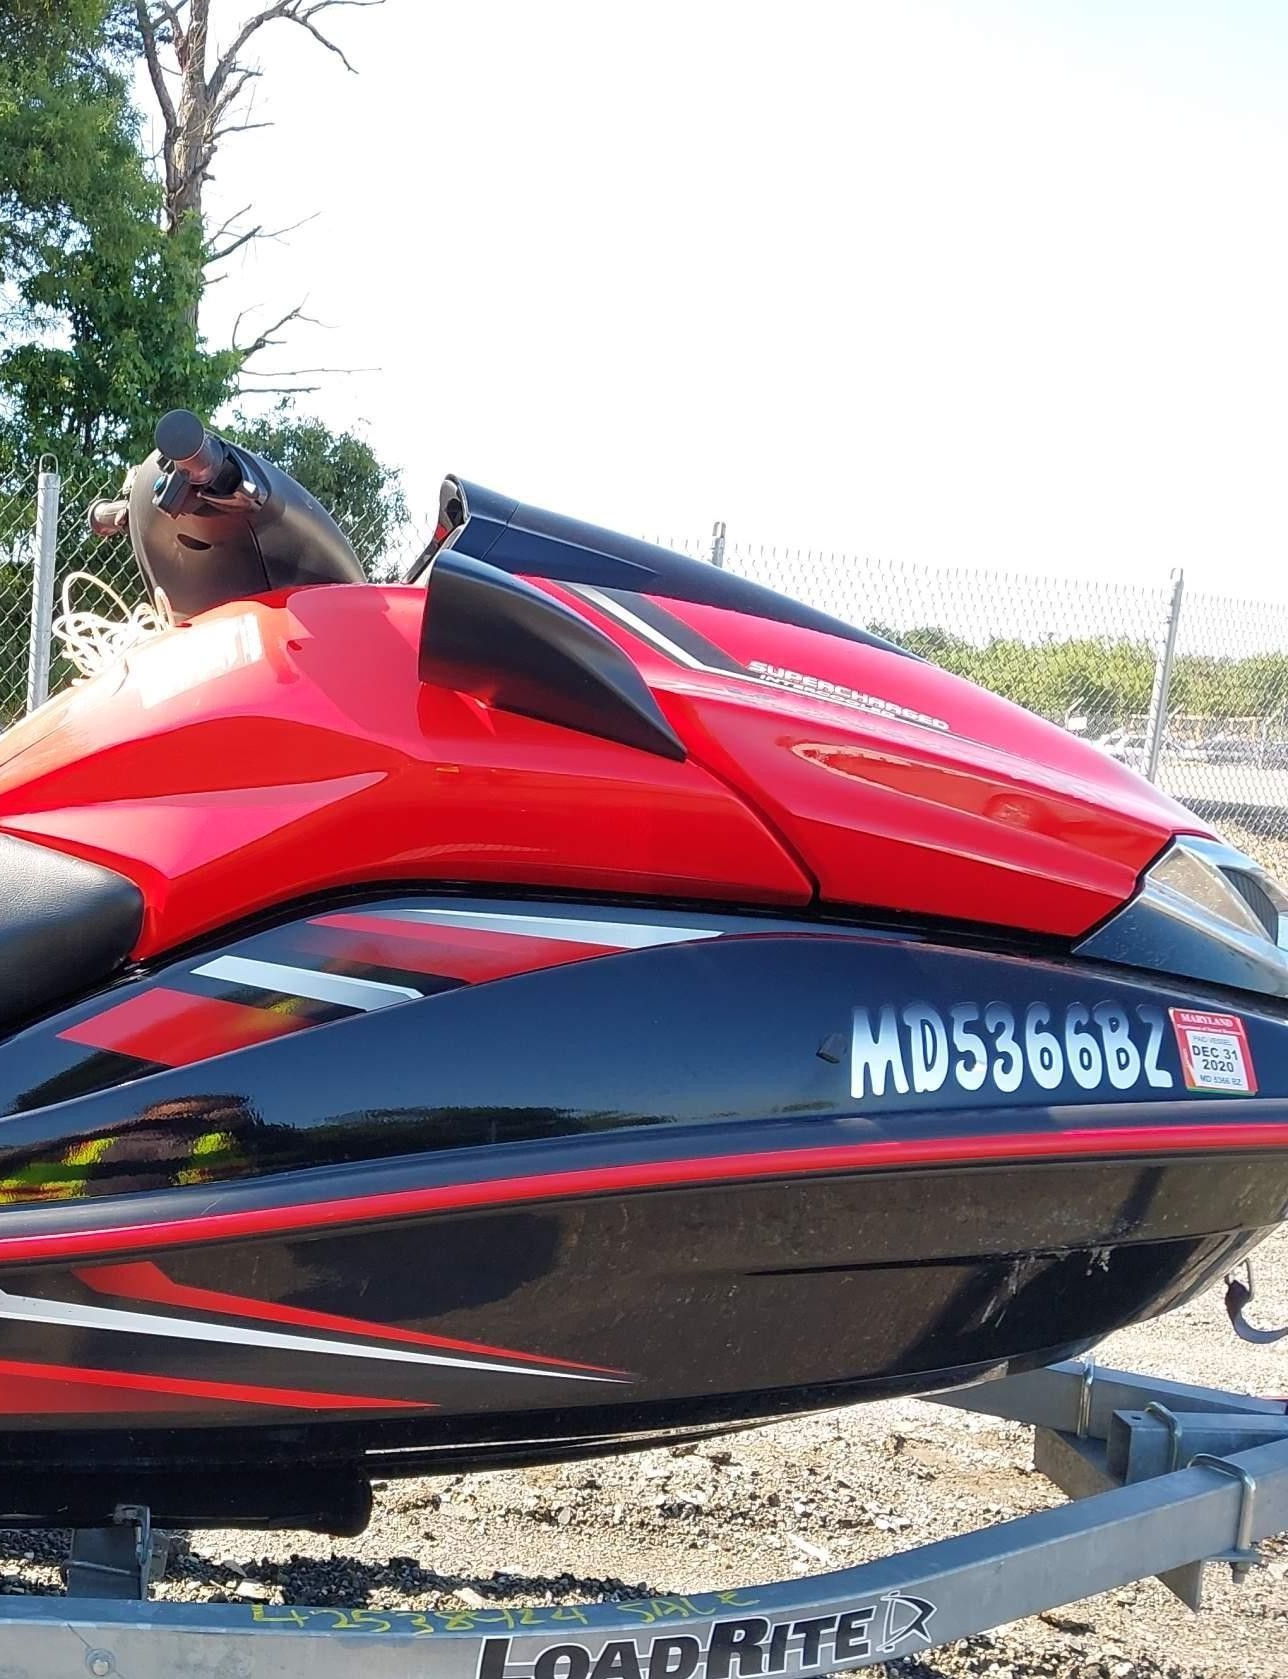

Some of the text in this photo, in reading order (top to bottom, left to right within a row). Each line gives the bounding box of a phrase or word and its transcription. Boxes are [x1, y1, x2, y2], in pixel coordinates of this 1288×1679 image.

[747, 661, 950, 731] SUPERCHARGED
[1180, 1013, 1234, 1028] MARYLAND
[1192, 1045, 1239, 1061] DEC 31
[1202, 1059, 1235, 1073] 2020
[616, 1589, 761, 1623] SALE
